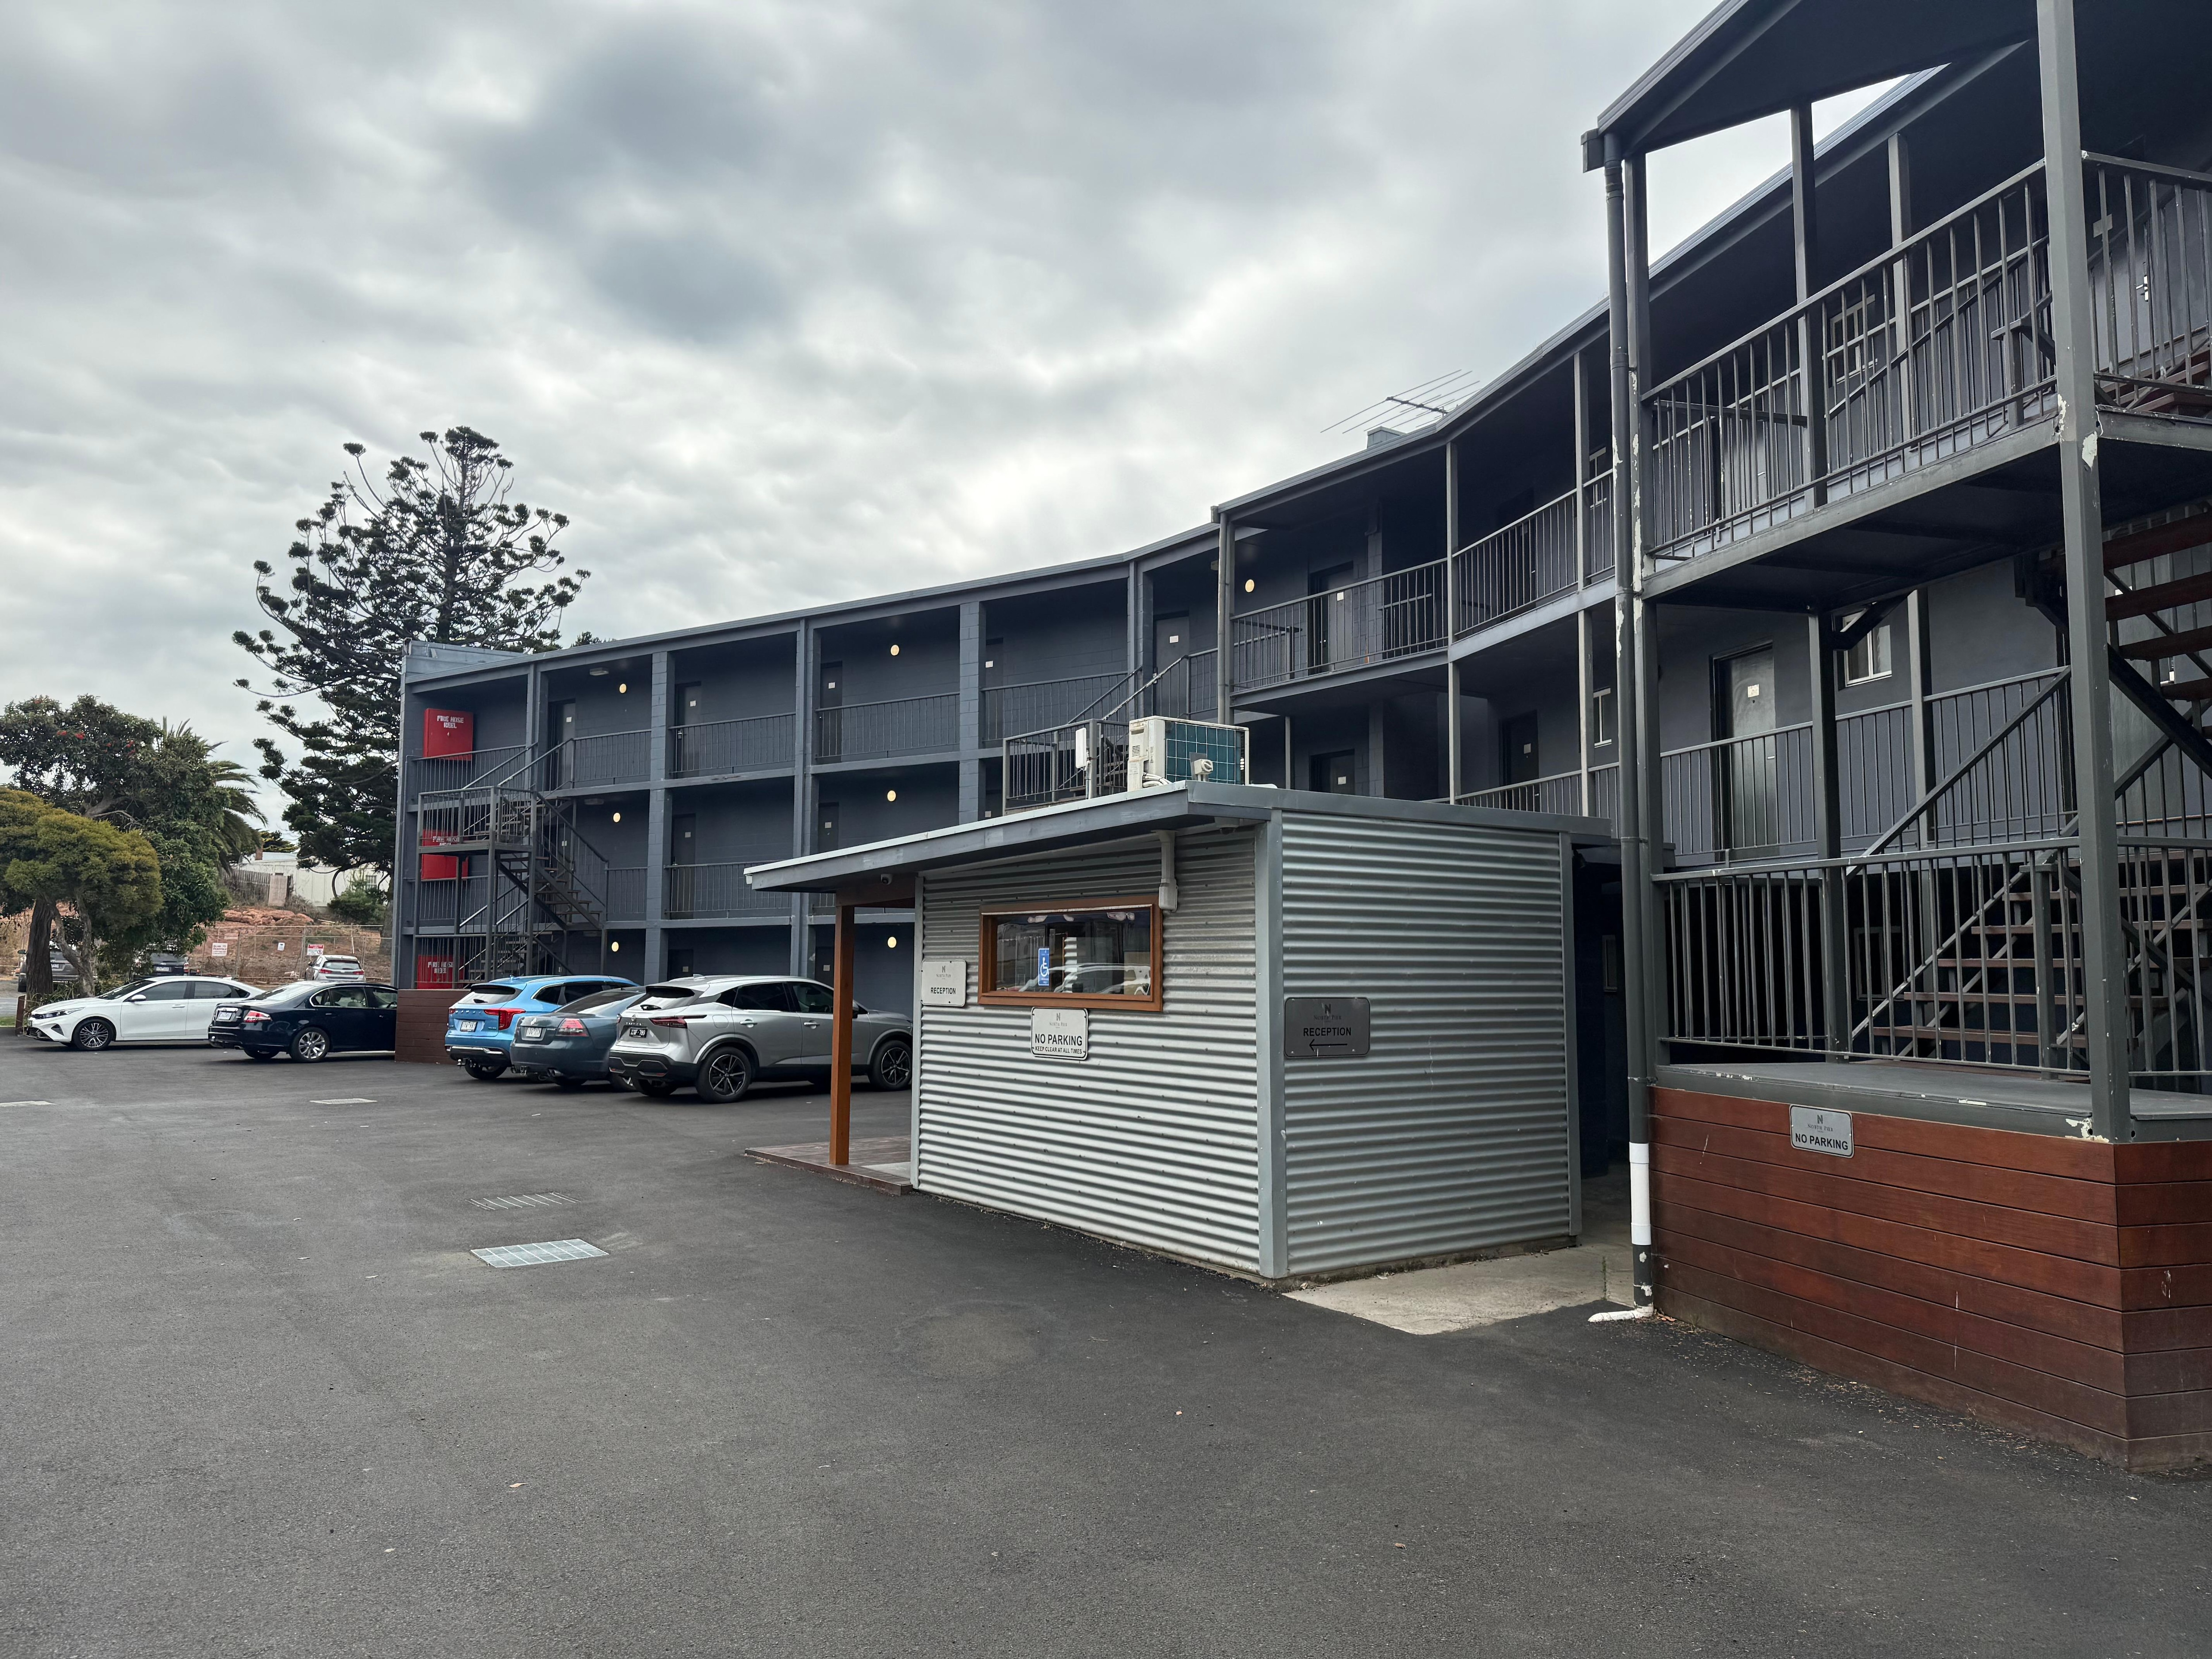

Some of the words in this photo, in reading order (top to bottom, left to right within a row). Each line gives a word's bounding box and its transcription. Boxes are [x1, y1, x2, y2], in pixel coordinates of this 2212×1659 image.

[1325, 1004, 1331, 1014] N
[1056, 1013, 1060, 1021] N
[1303, 1027, 1351, 1037] RECEPTION
[1035, 1033, 1045, 1044] NO
[1048, 1034, 1082, 1046] PARKING
[1817, 1114, 1823, 1124] N
[1795, 1133, 1807, 1143] NO
[1810, 1136, 1848, 1150] PARKING
